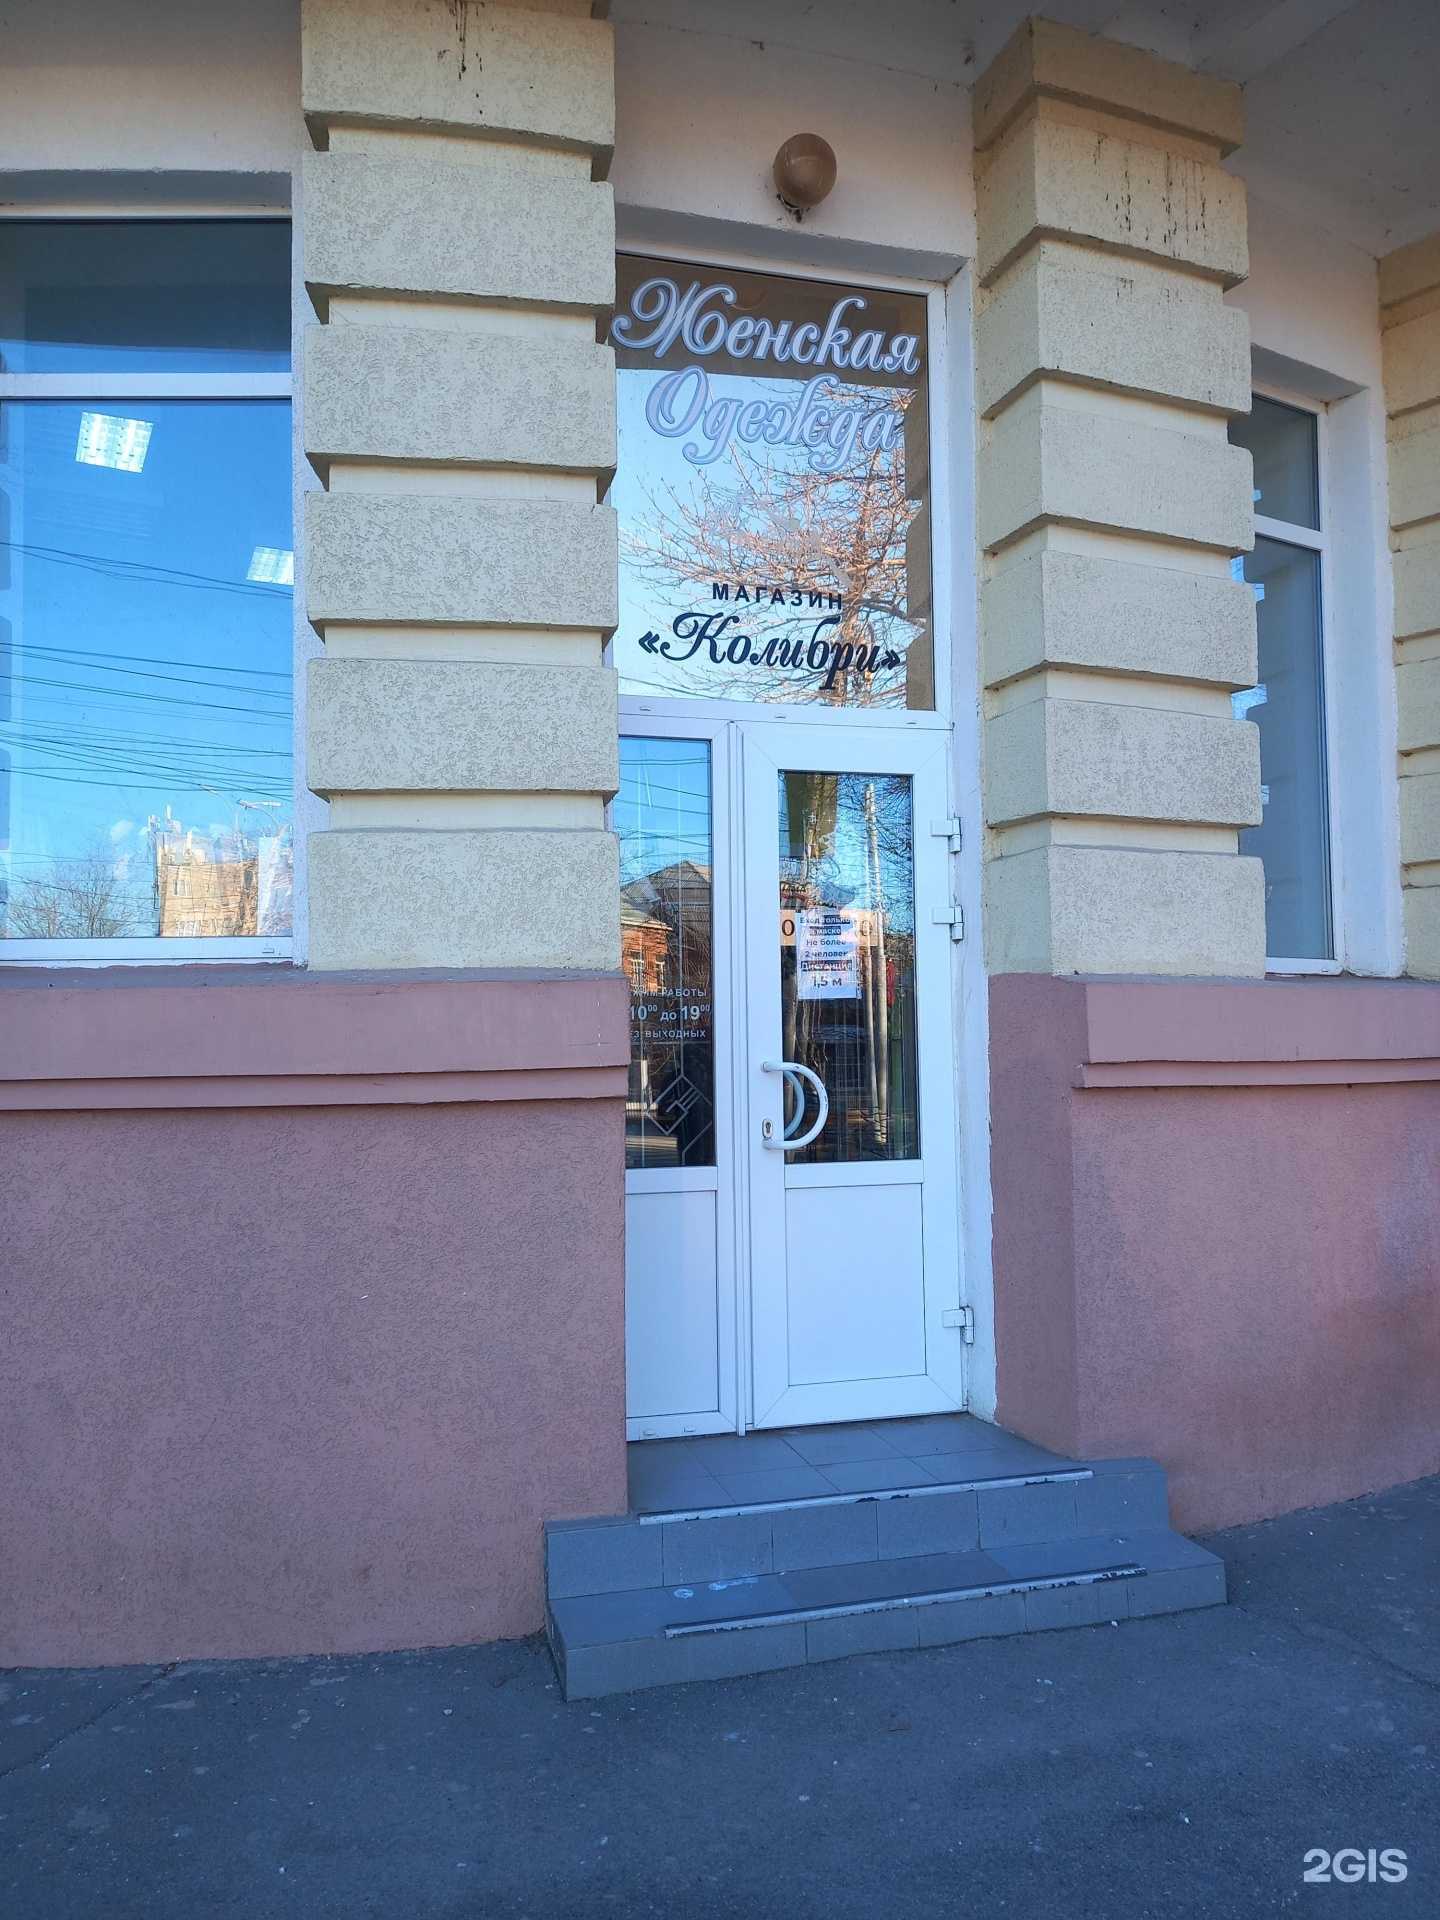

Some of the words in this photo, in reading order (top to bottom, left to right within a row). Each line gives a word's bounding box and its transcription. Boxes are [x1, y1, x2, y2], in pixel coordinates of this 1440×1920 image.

[611, 277, 920, 376] Женская
[645, 365, 900, 473] Одежда
[712, 582, 843, 610] МАГАЗИН
[638, 611, 901, 691] «Колибри»
[813, 975, 829, 988] 1,5
[661, 987, 707, 997] РАБОТЫ
[660, 1010, 677, 1021] до
[645, 1030, 706, 1039] ВЫХОДНЫХ
